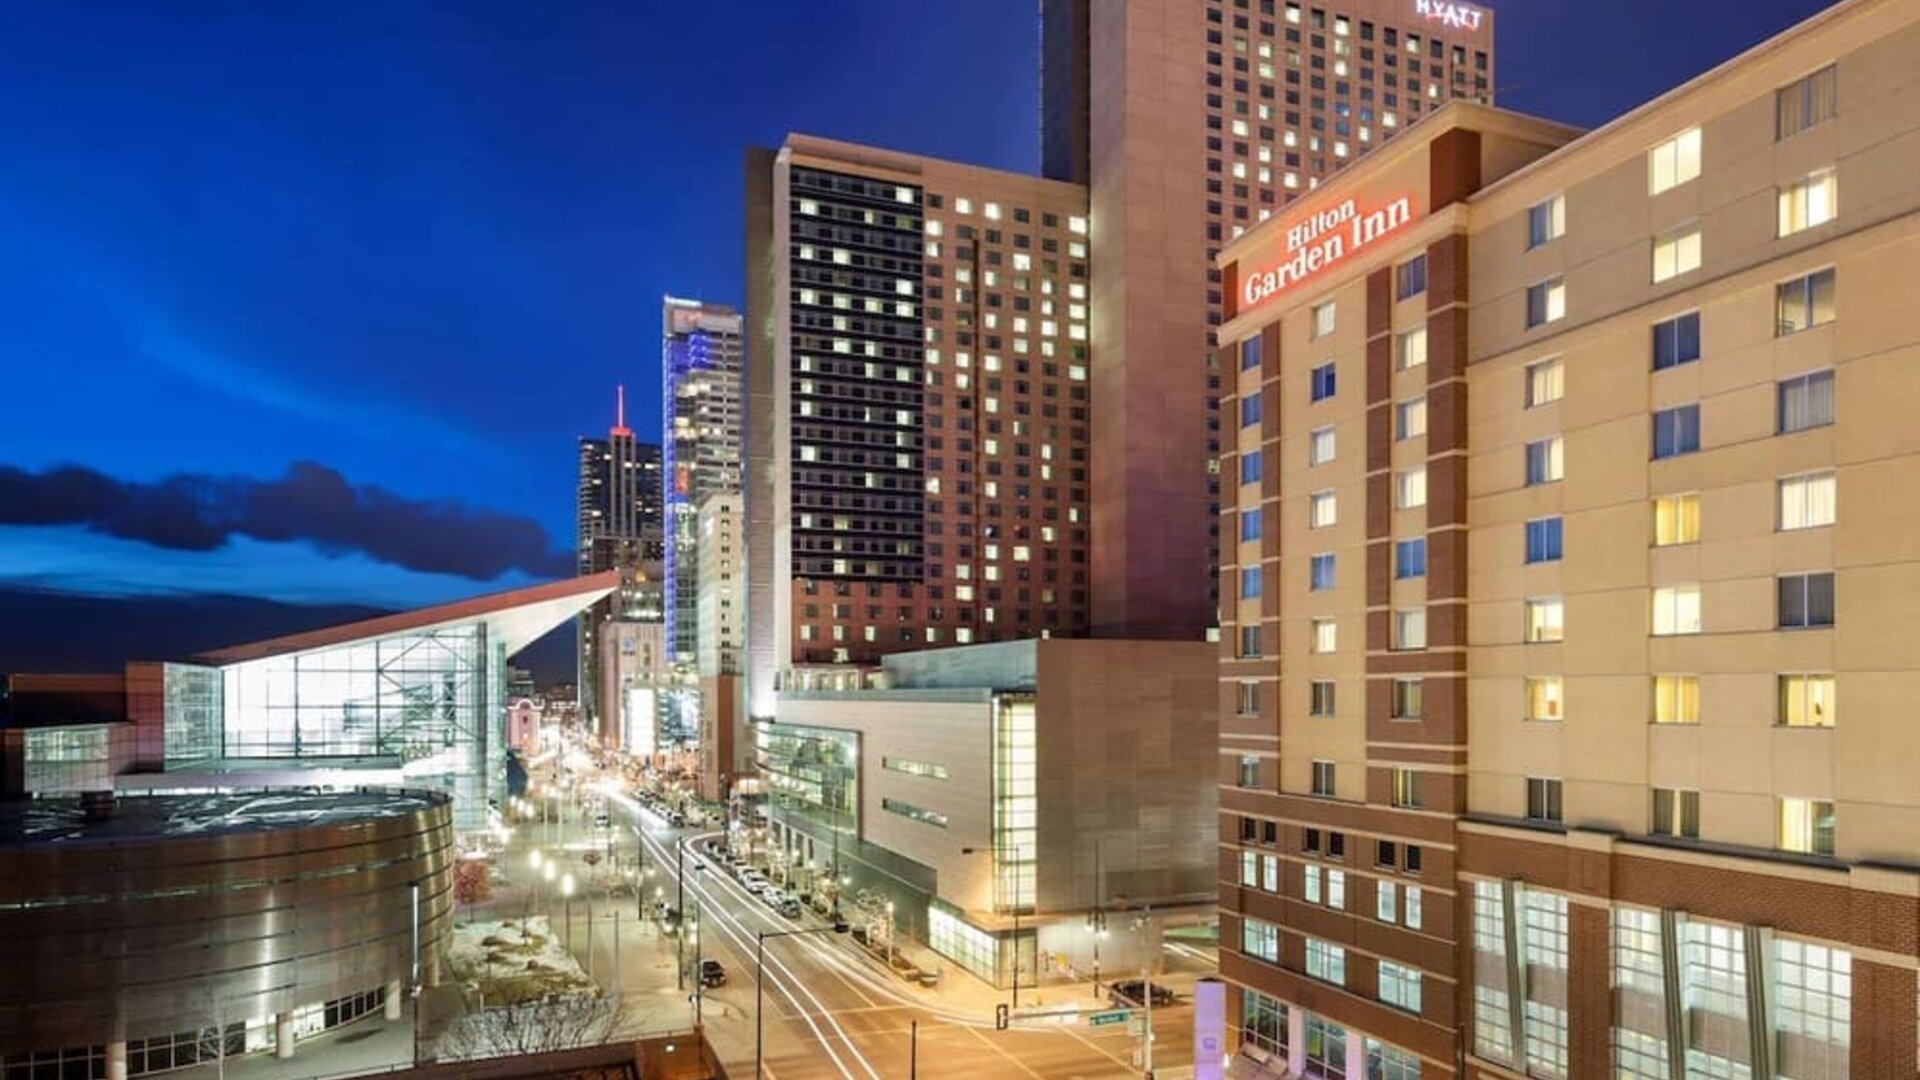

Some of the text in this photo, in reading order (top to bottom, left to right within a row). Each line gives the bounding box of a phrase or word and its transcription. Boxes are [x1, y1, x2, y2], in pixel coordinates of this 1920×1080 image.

[1416, 0, 1482, 28] HYATT
[1245, 197, 1411, 304] Garden Inn
[1287, 199, 1356, 252] Hilton
